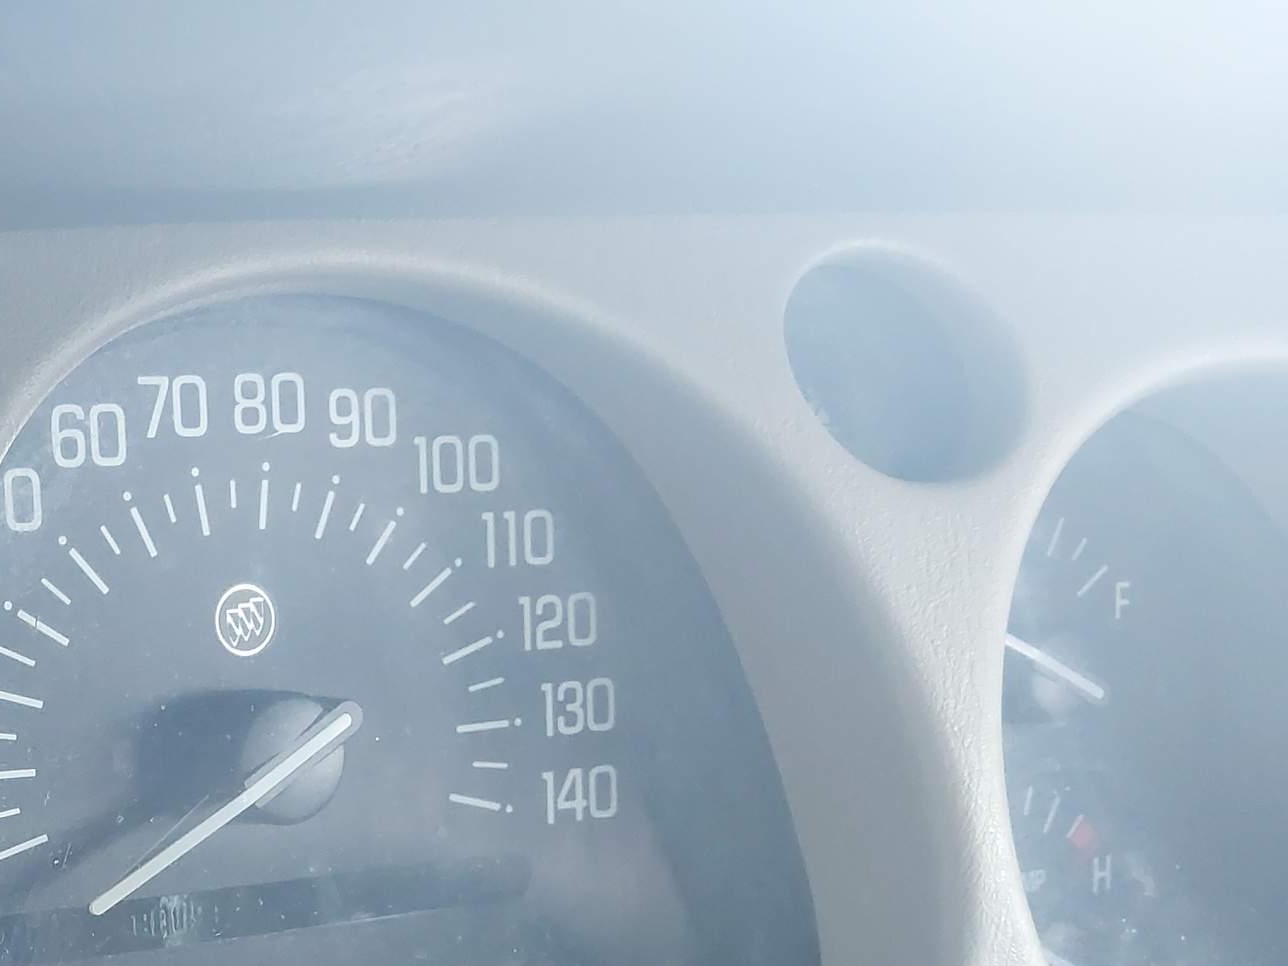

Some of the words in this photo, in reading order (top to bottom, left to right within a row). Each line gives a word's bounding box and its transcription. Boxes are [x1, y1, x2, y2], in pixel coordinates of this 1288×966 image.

[137, 375, 208, 438] 70
[233, 372, 307, 435] 80
[328, 387, 398, 448] 90
[49, 403, 127, 468] 60
[413, 434, 500, 493] 100
[481, 509, 555, 567] 110
[517, 592, 598, 651] 120
[1114, 581, 1131, 619] F
[540, 677, 615, 737] 130
[541, 764, 618, 824] 140
[1093, 854, 1112, 895] H
